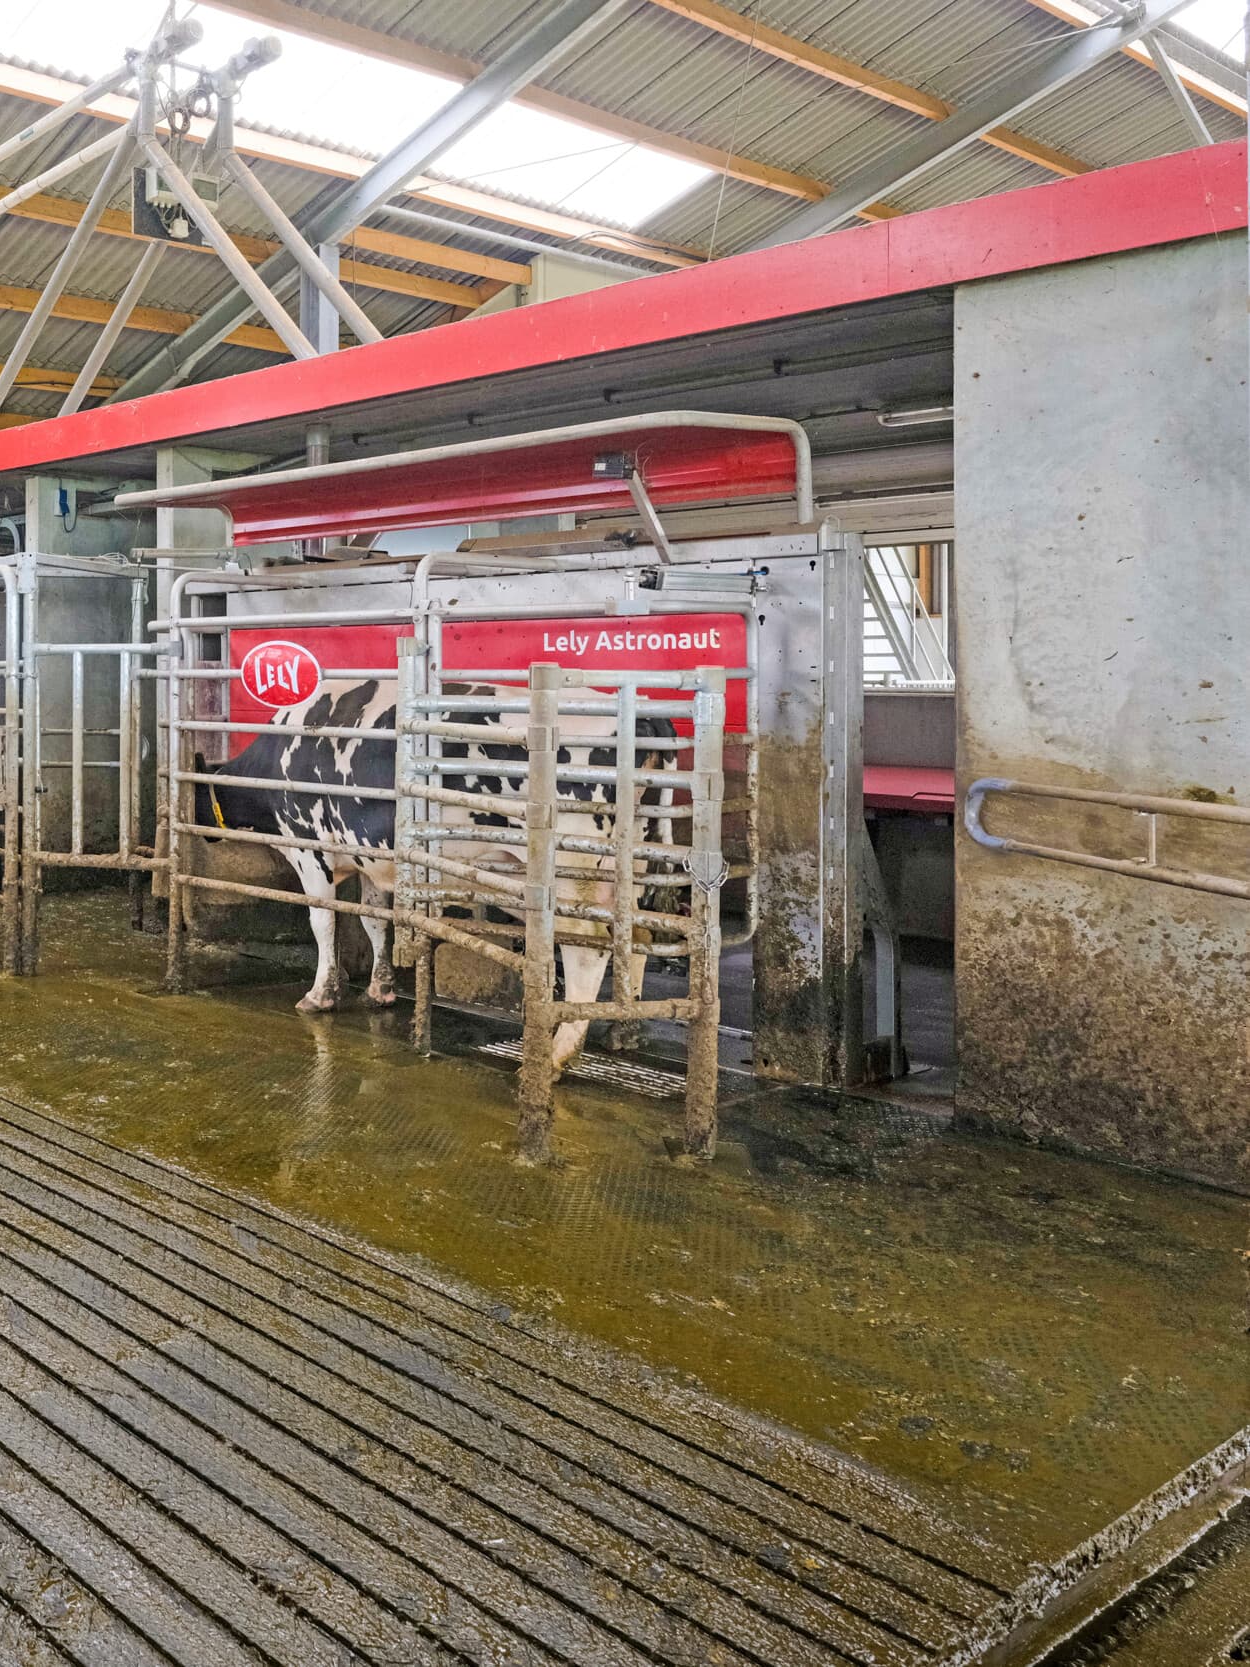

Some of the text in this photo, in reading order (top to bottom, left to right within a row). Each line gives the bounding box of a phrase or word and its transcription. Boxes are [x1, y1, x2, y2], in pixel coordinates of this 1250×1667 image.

[543, 628, 721, 656] Lely Astronaut
[254, 654, 301, 696] LELY
